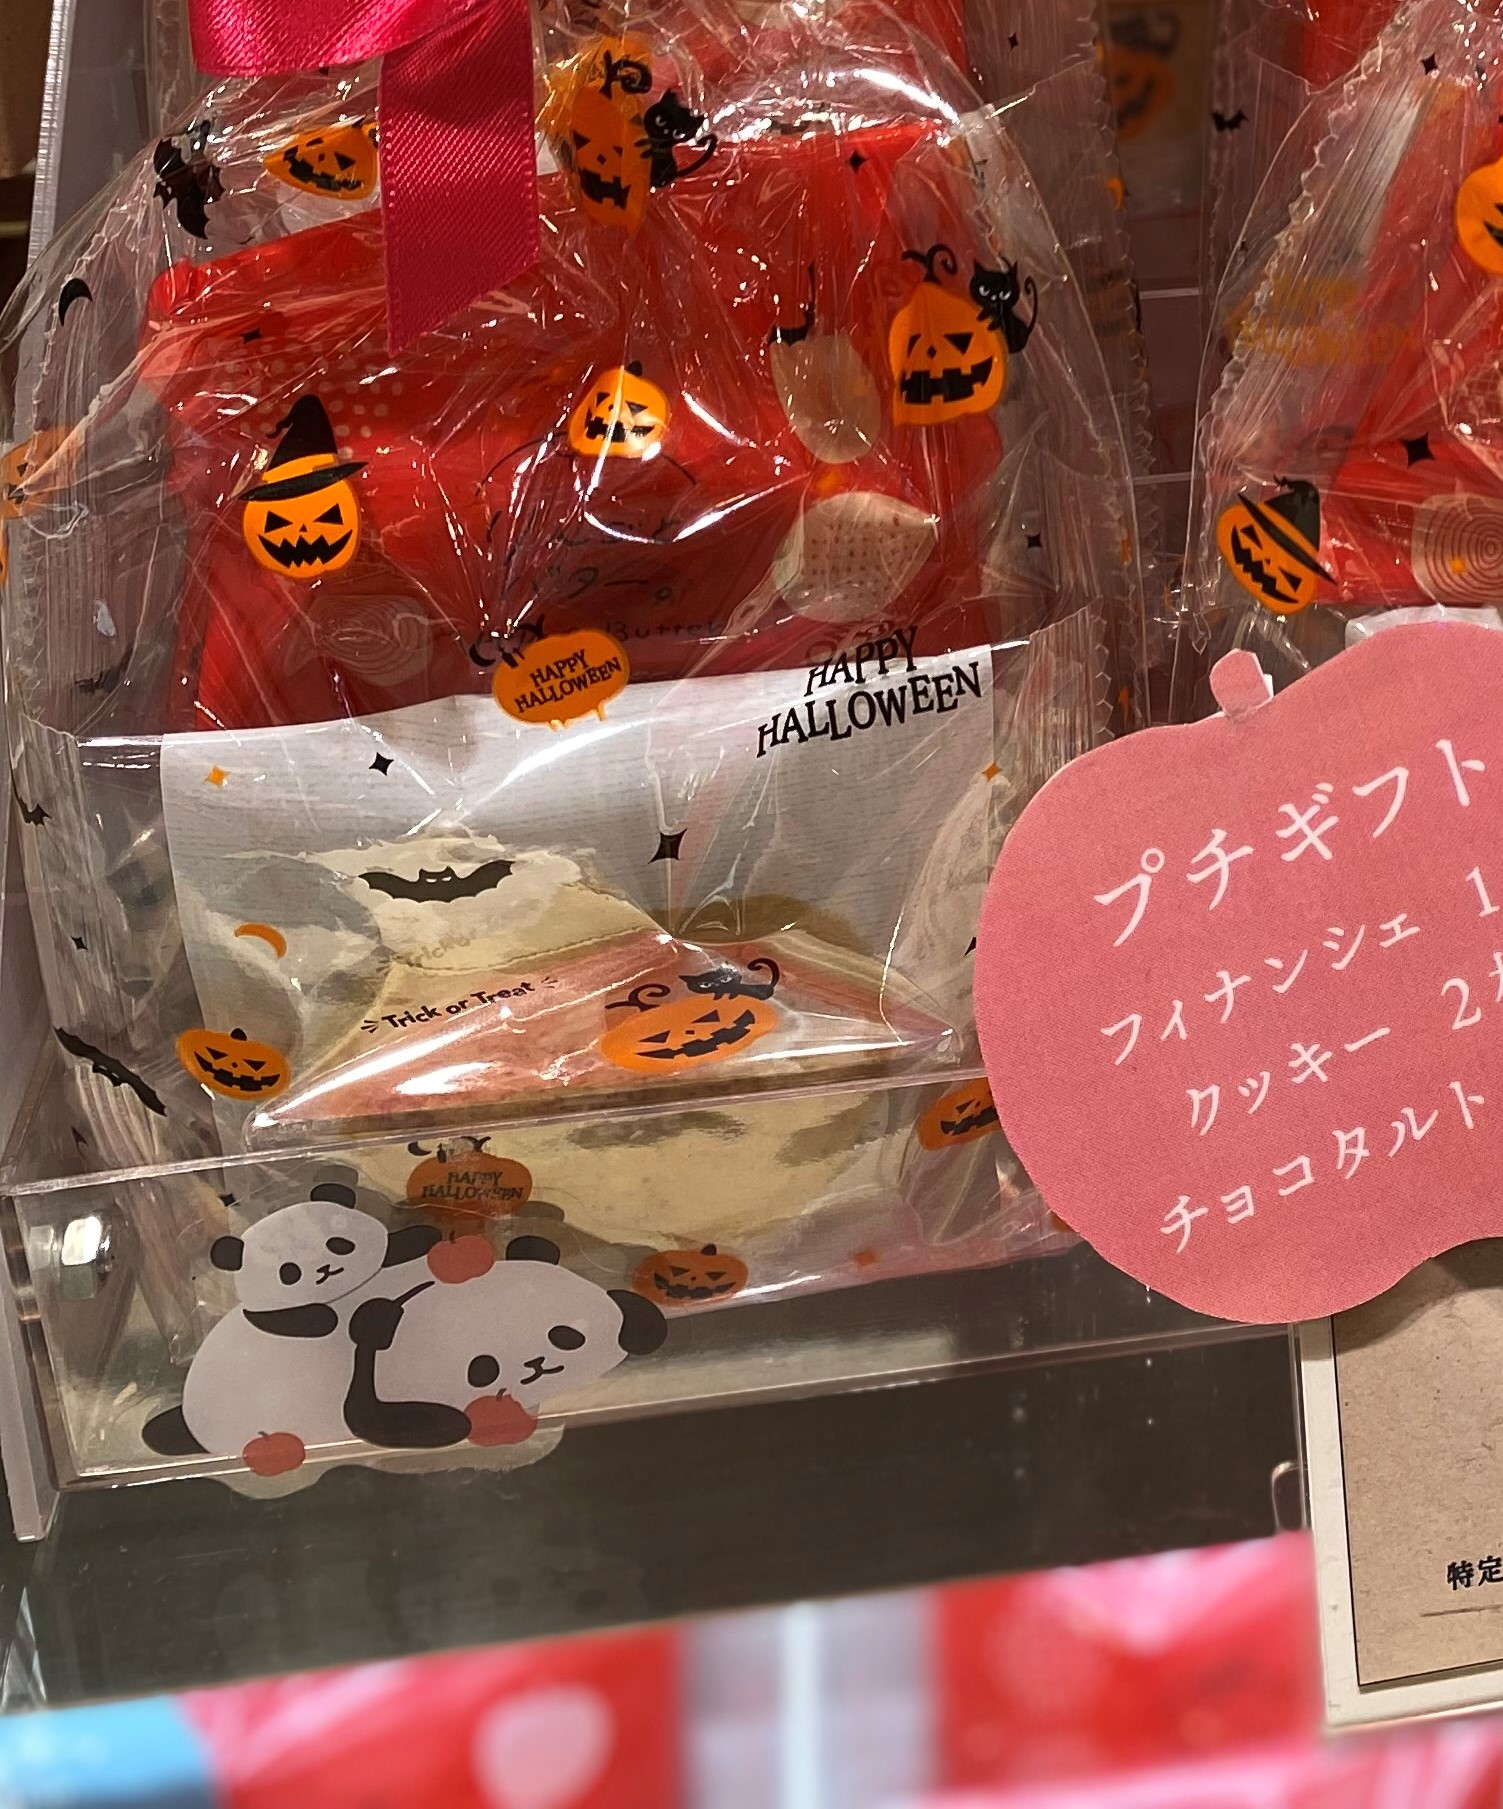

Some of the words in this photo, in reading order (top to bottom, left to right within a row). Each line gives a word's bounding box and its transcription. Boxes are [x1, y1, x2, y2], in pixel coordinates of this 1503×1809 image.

[515, 657, 622, 714] HALLOWEEN
[530, 649, 589, 688] HAPPY
[756, 661, 983, 758] HALLOWEEN
[804, 625, 918, 697] HAPPY
[1093, 738, 1487, 948] プチギフト
[381, 1004, 442, 1029] Trick
[445, 998, 469, 1017] or
[469, 981, 536, 1005] Treat
[1100, 912, 1422, 1066] フィナンシェ
[1186, 1024, 1392, 1136] クッキー
[1159, 1079, 1486, 1254] チョコタルト
